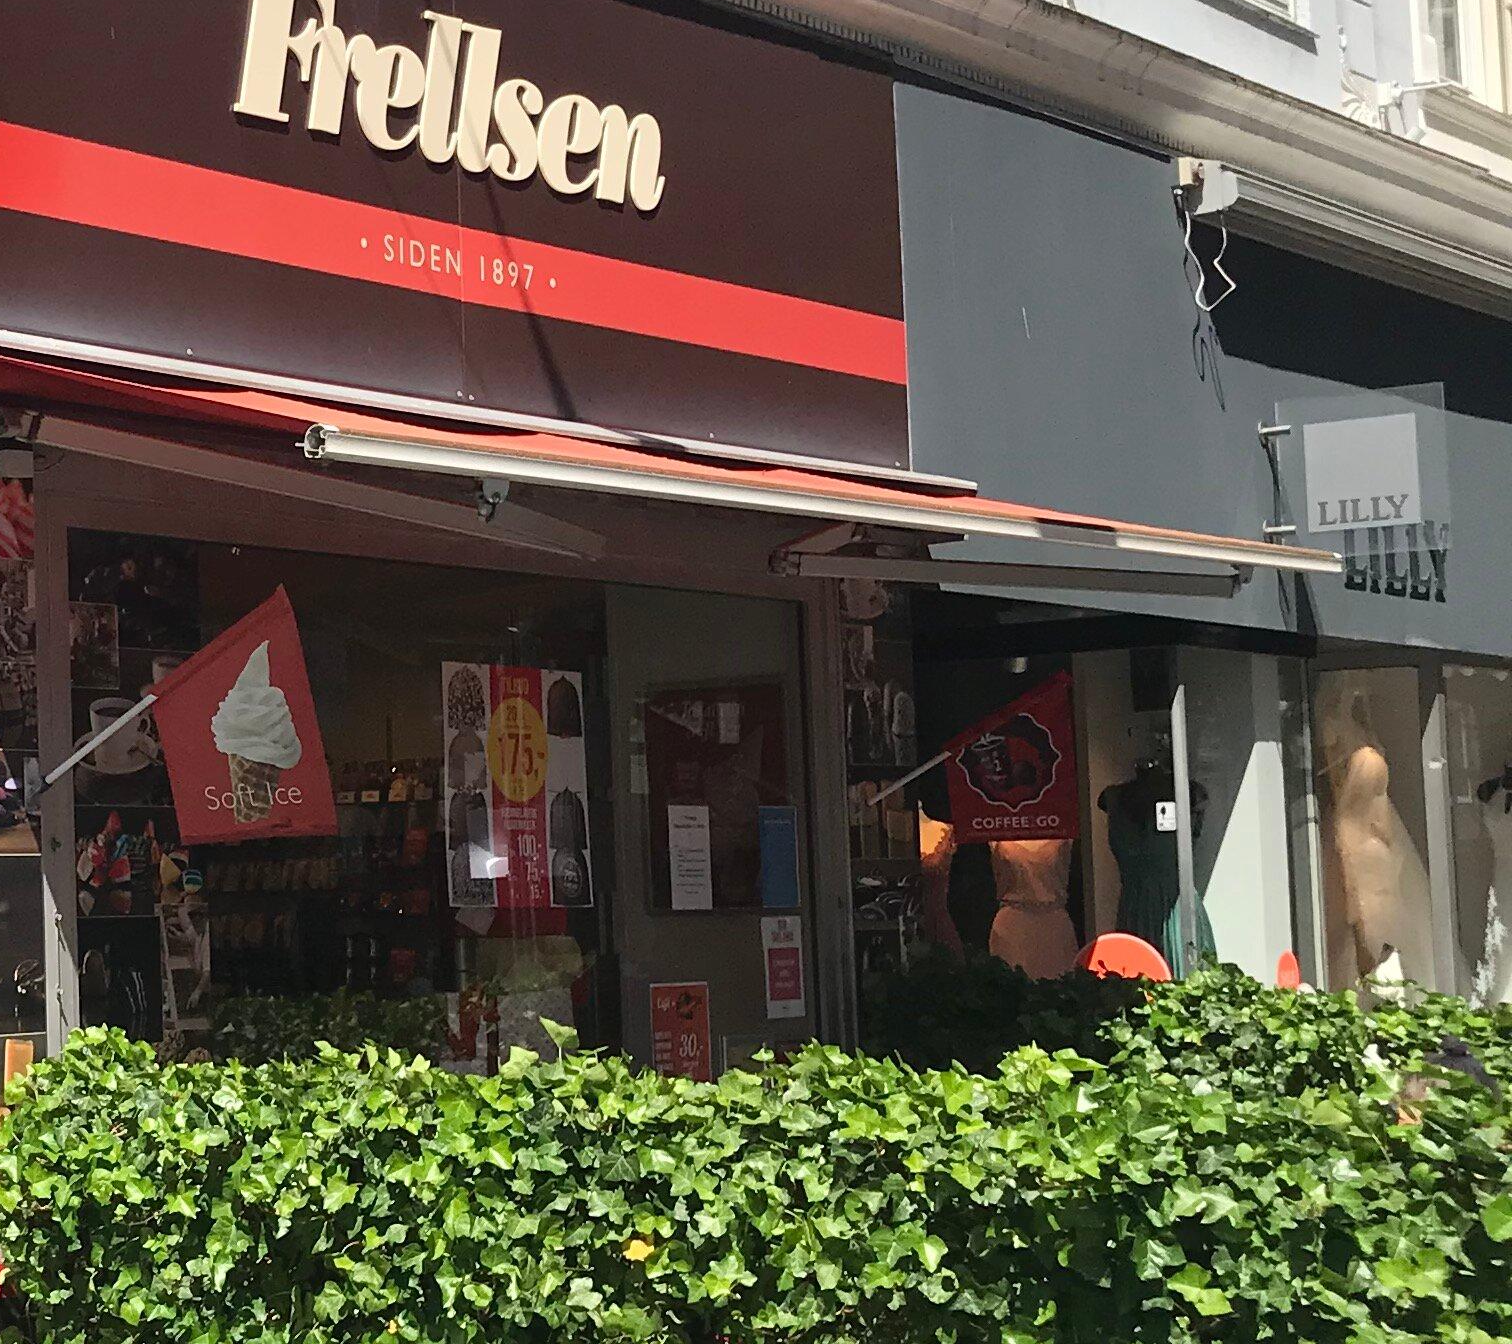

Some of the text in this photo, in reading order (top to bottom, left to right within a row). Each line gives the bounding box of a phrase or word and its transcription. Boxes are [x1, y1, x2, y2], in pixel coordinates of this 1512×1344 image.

[383, 234, 534, 290] SIDEN 1897
[1317, 494, 1409, 526] LILLY
[204, 781, 303, 812] Soft Ice
[972, 815, 1060, 830] COFFEE GO
